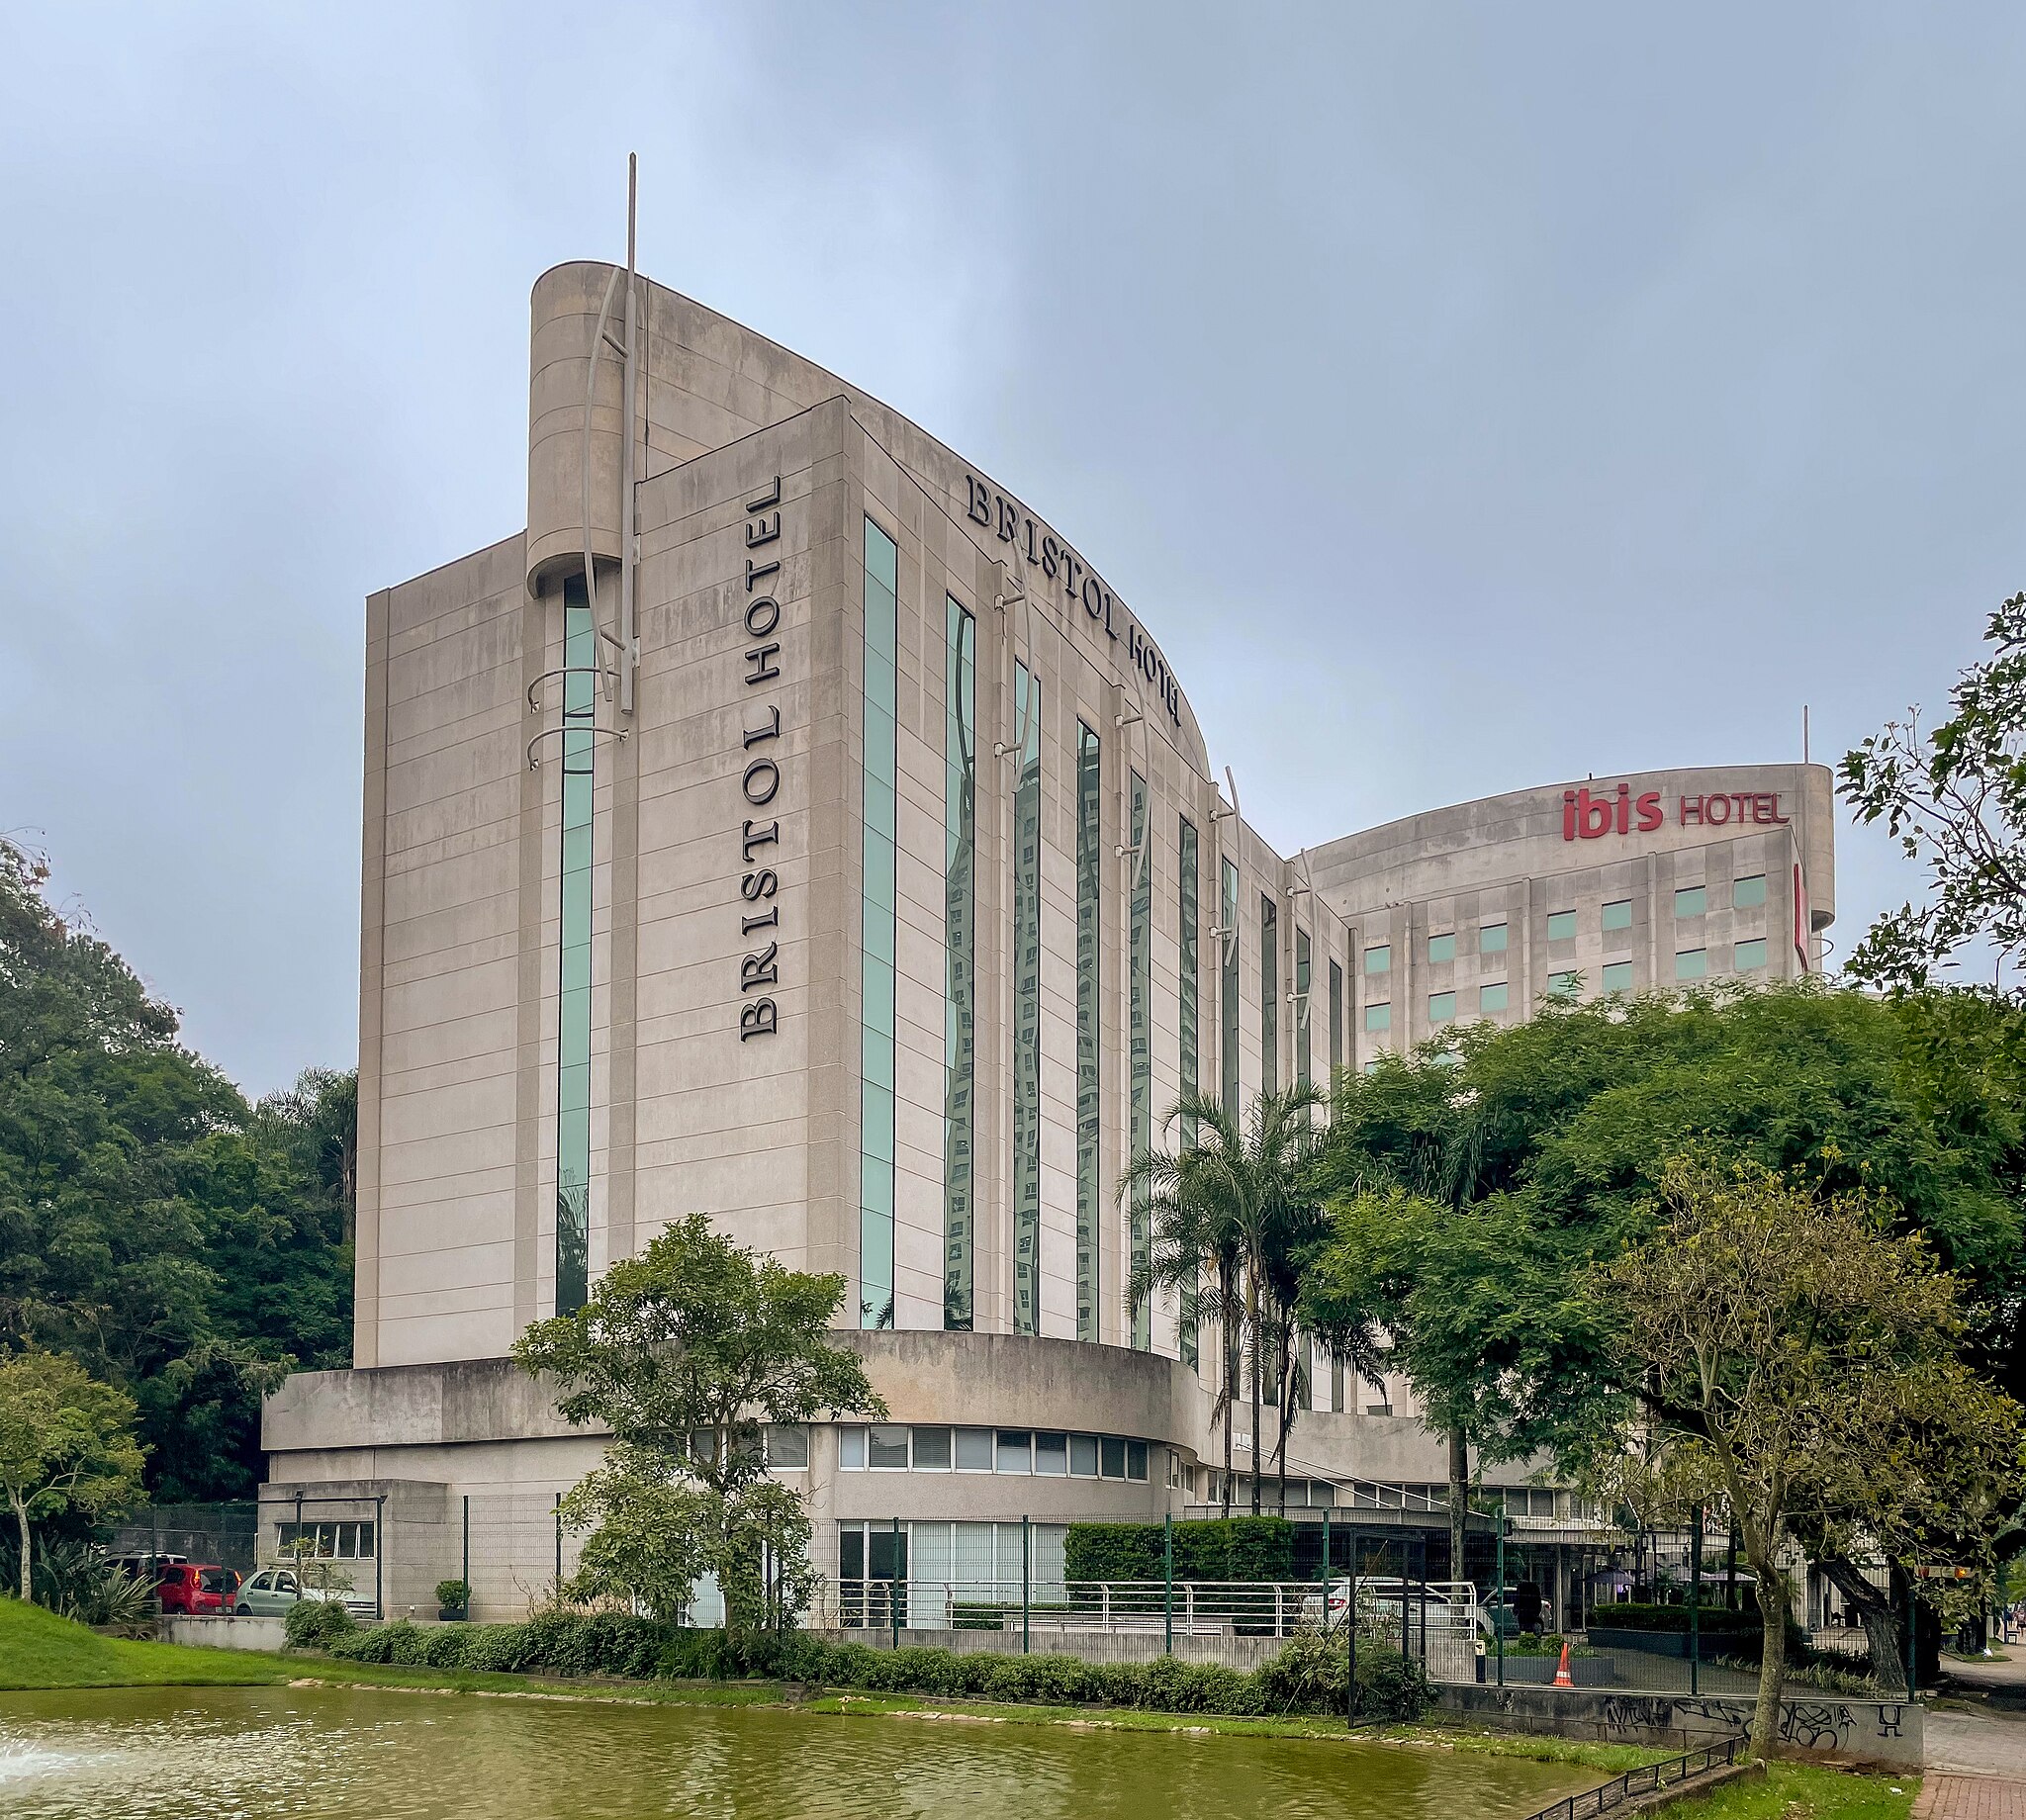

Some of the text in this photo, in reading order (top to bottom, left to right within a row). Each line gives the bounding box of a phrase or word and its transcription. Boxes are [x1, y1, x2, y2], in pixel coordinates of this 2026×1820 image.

[966, 474, 1120, 640] BRISTOL
[740, 475, 782, 1043] BRISTOL HOTEL
[1563, 783, 1791, 841] ibis HOTEL
